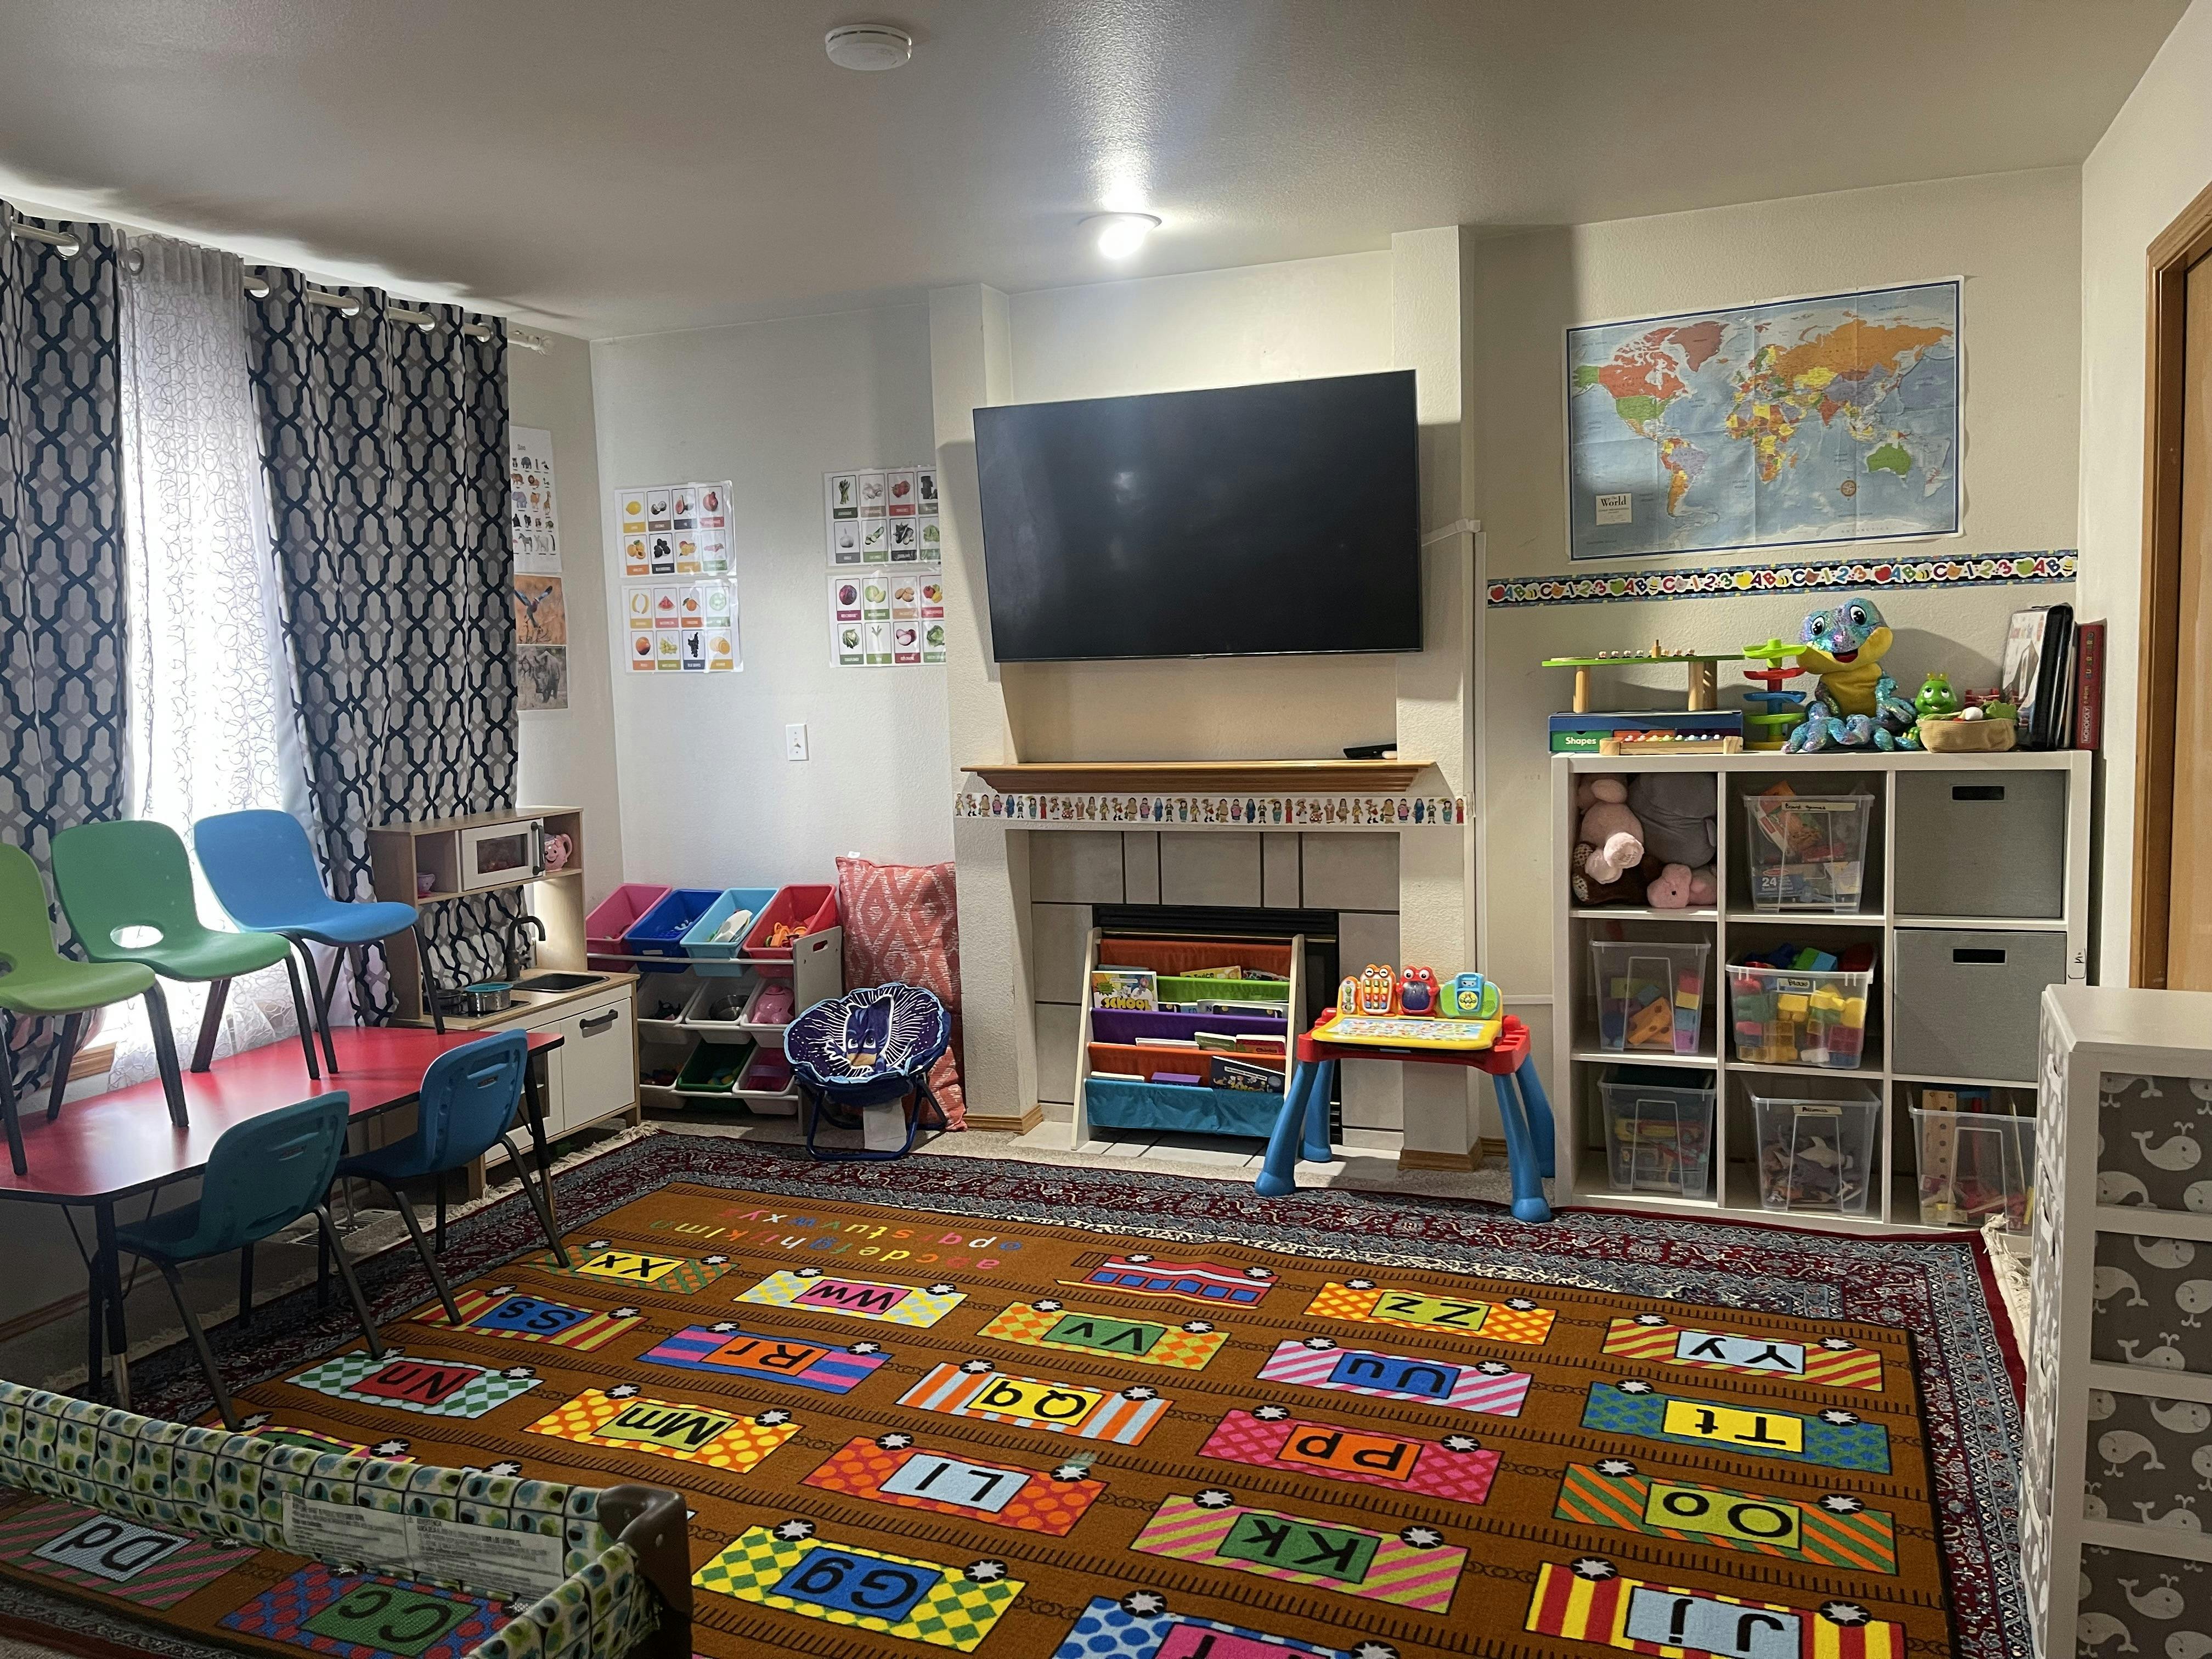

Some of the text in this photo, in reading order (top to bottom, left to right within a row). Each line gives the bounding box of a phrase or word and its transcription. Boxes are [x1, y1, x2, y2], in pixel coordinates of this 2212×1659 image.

[1600, 495, 1627, 506] World
[1565, 736, 1596, 746] Shapes
[2083, 707, 2091, 742] MONOPOLY
[1762, 877, 1777, 887] 24
[1102, 996, 1153, 1011] SCHOOL
[600, 1255, 653, 1277] Xx
[498, 1301, 576, 1329] Ss
[807, 1286, 894, 1310] Ww
[1385, 1297, 1480, 1326] Zz
[725, 1341, 814, 1369] Rr
[1062, 1323, 1142, 1353] Vv
[1689, 1338, 1796, 1373] Yy
[376, 1365, 469, 1399] Nn
[1347, 1357, 1454, 1393] Uu
[980, 1380, 1086, 1418] Qq
[616, 1408, 726, 1445] Mm
[1696, 1409, 1786, 1445] Tt
[1297, 1433, 1407, 1471] Pp
[915, 1463, 1003, 1502] Ll
[1663, 1492, 1792, 1537] Oo
[50, 1521, 167, 1572] Dd
[1242, 1520, 1360, 1573] Kk
[800, 1559, 919, 1610] Gg
[338, 1590, 454, 1644] Cc
[1669, 1599, 1784, 1652] Jj
